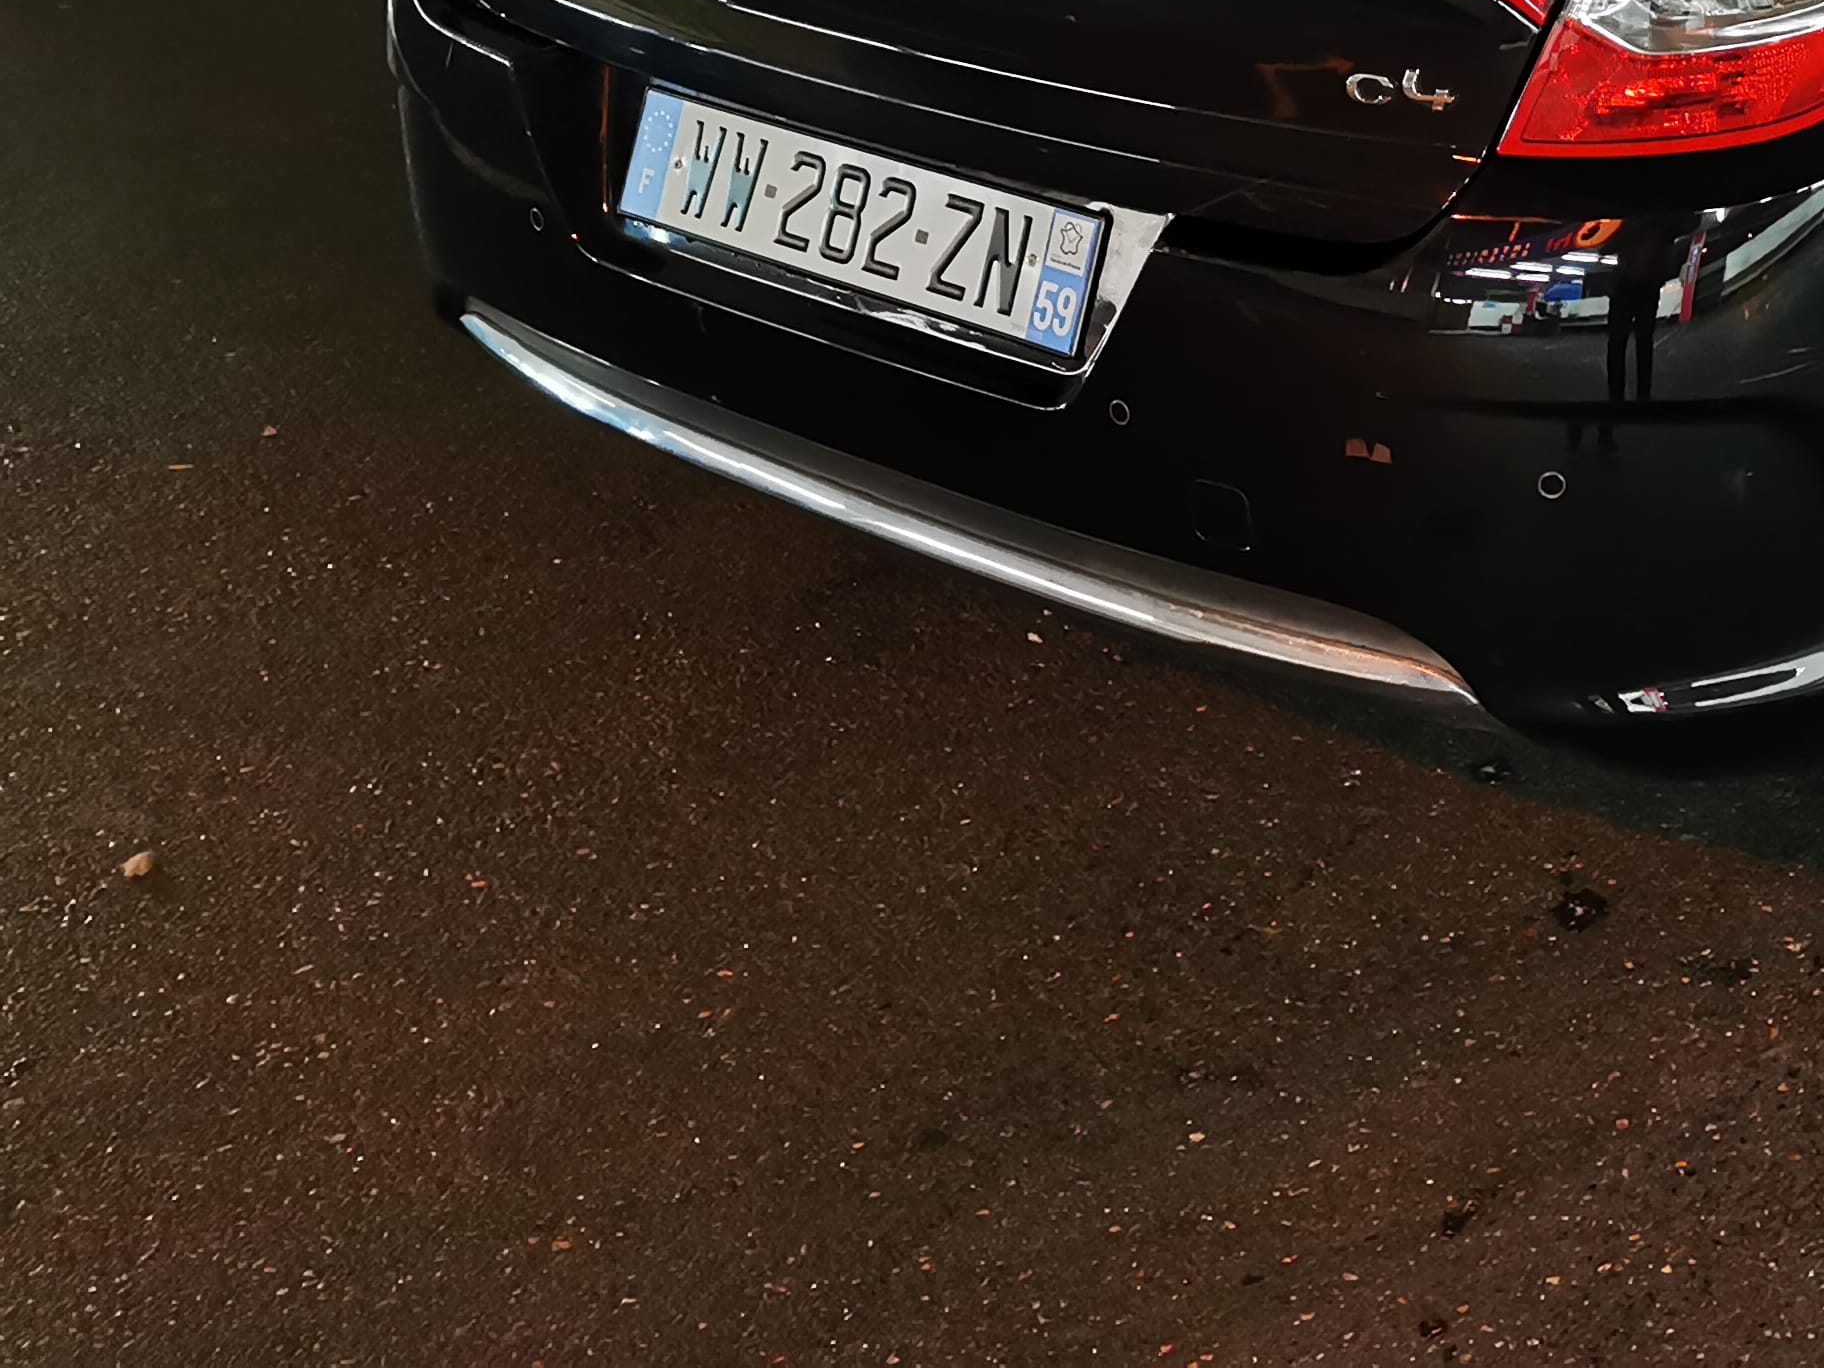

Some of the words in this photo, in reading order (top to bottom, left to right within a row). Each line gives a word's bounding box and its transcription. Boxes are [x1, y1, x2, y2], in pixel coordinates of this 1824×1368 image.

[1346, 68, 1456, 112] C4
[638, 167, 654, 195] F
[680, 120, 1033, 317] WW-282-ZN
[1032, 280, 1077, 336] 59
